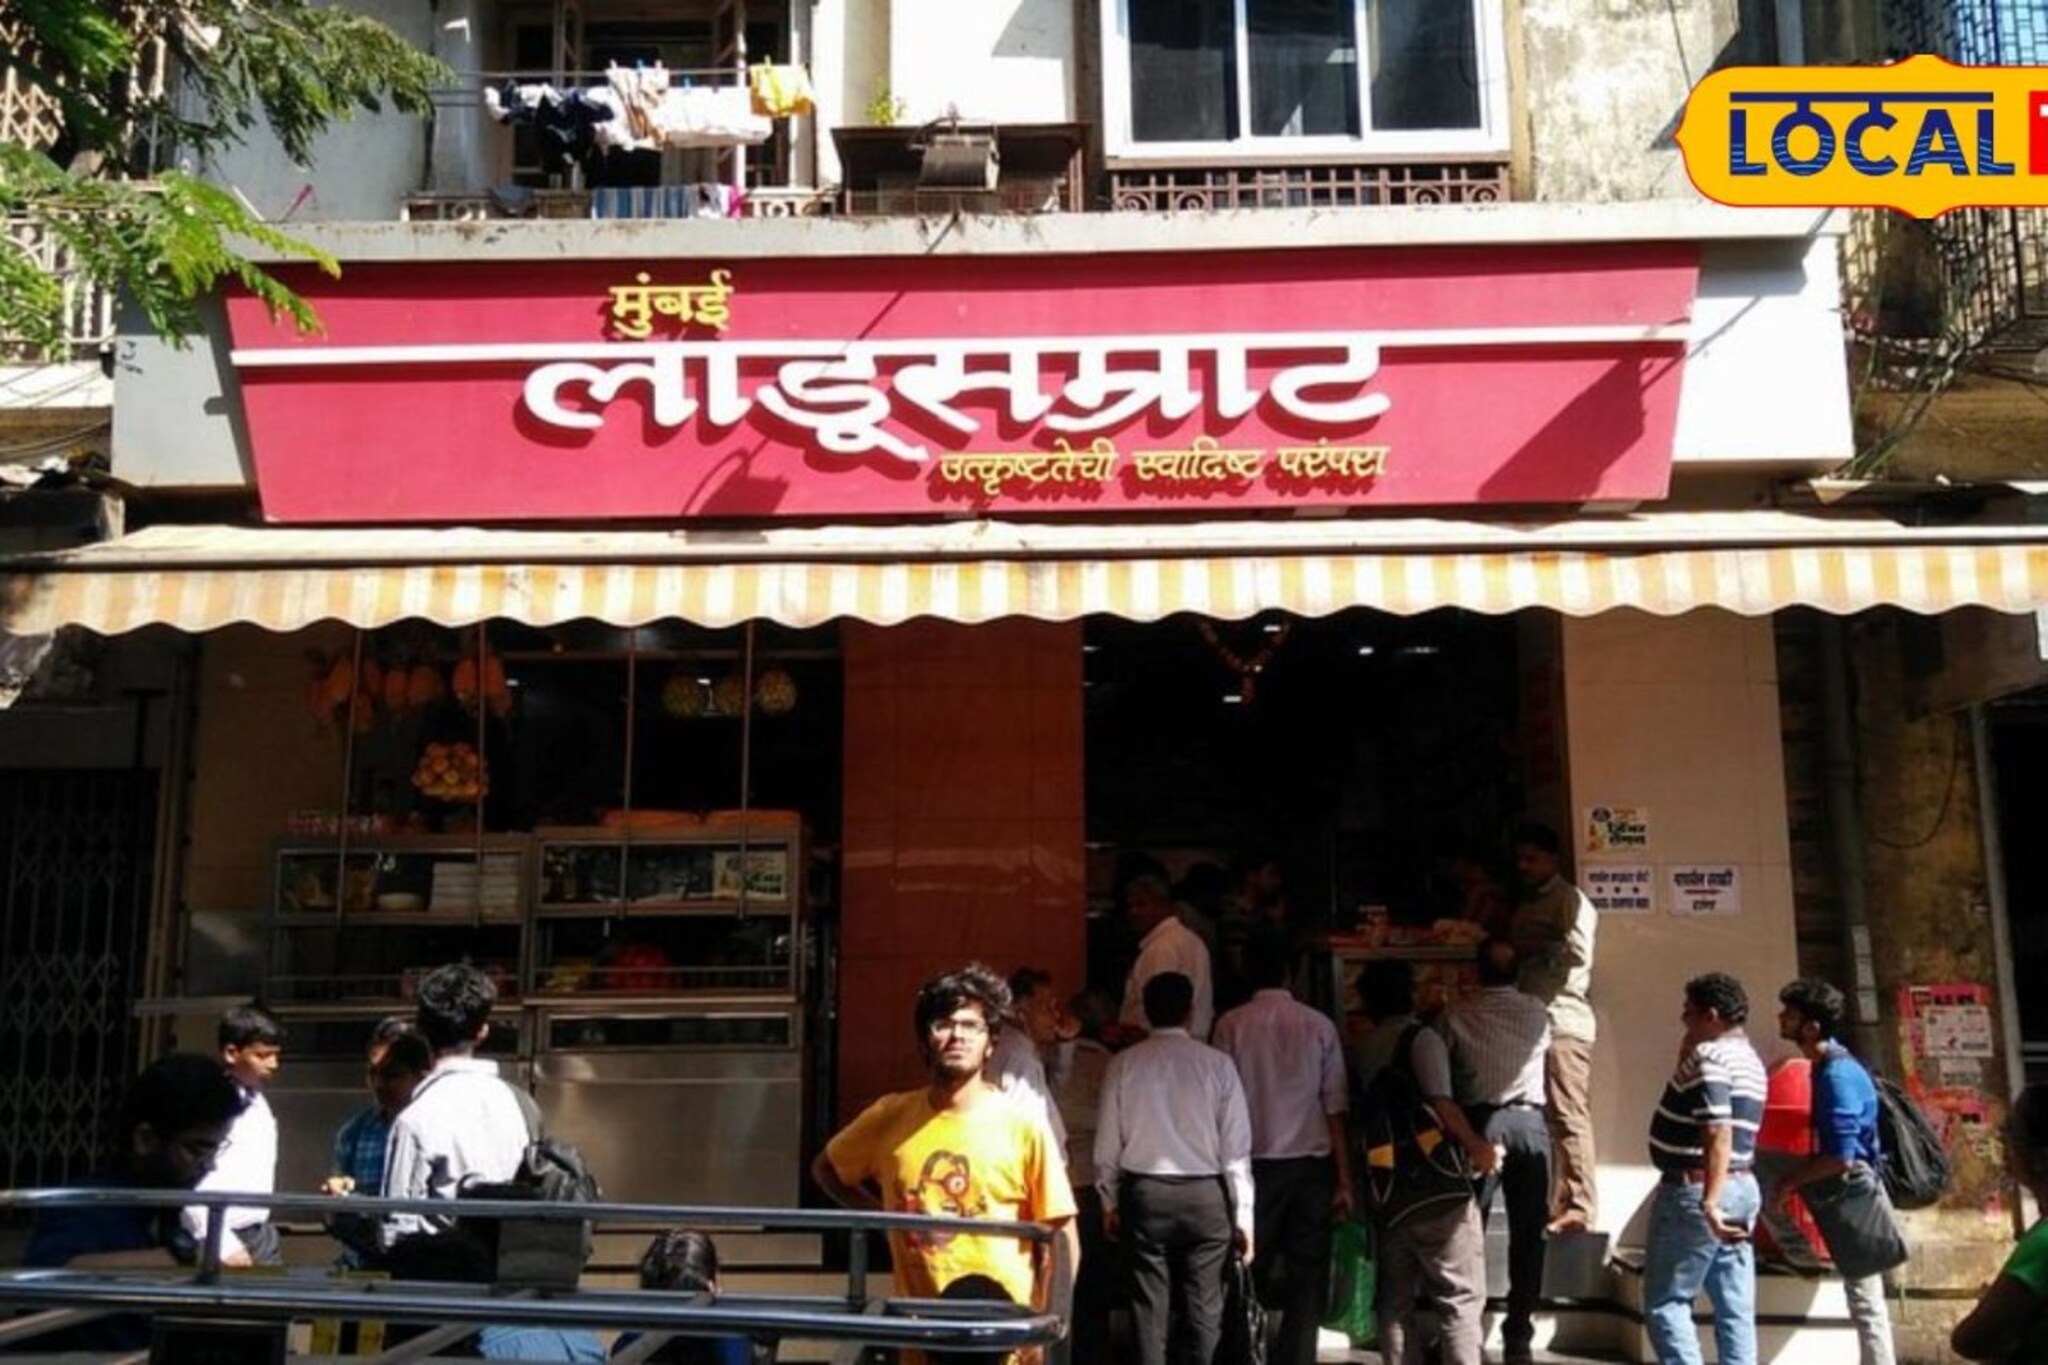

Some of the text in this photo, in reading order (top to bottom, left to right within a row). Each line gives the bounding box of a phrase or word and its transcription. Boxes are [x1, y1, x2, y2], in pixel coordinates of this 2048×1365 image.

[609, 269, 734, 338] मुंबई
[940, 436, 1390, 495] उत्कृष्टतेची स्वादिष्ट परंपरा
